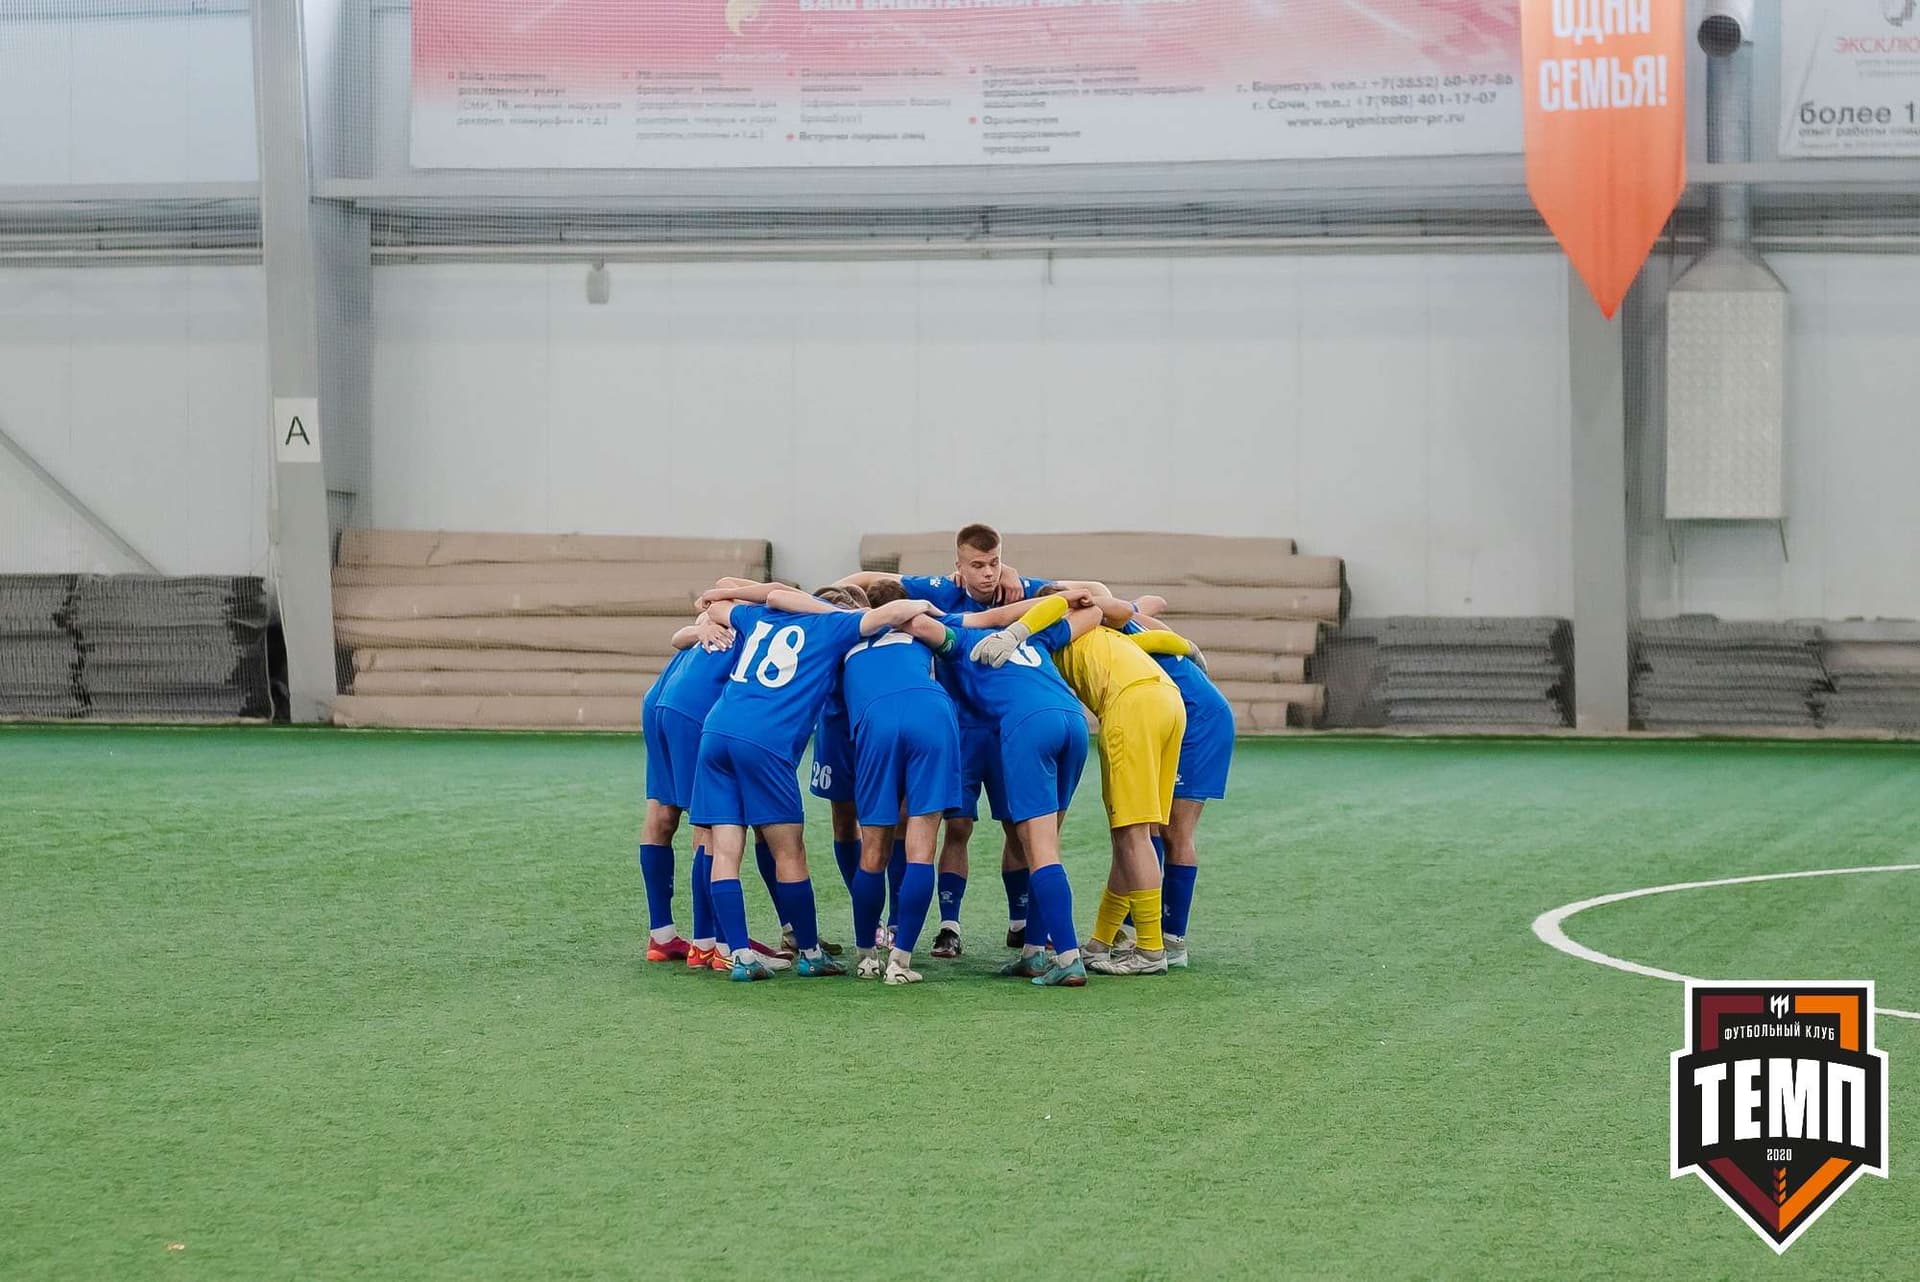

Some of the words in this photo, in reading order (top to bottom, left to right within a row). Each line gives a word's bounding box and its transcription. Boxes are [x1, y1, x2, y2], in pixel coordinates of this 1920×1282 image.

[1552, 0, 1652, 45] ОДНА
[1540, 54, 1668, 112] СЕМЬЯ!
[1800, 100, 1892, 125] более
[730, 621, 805, 688] 18
[811, 760, 832, 790] 26
